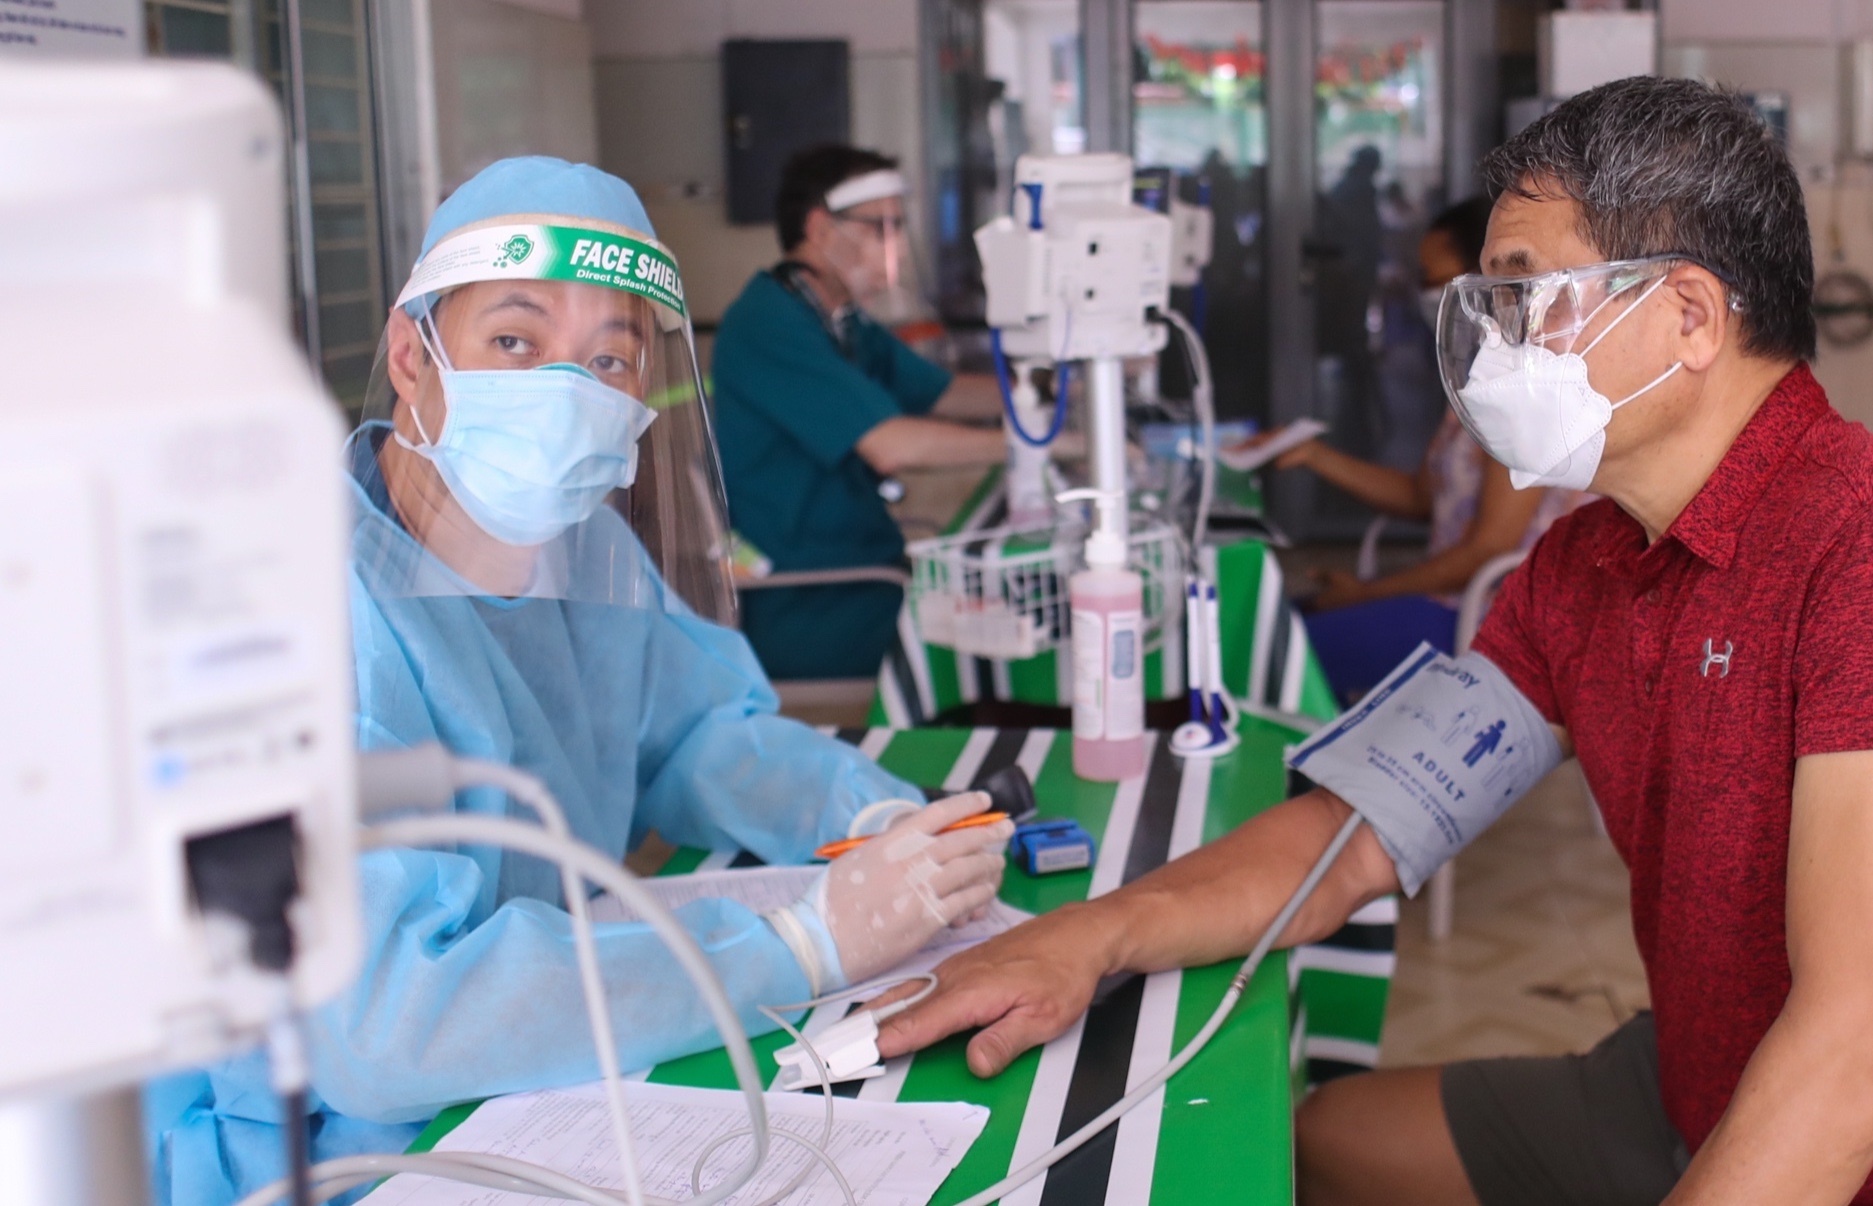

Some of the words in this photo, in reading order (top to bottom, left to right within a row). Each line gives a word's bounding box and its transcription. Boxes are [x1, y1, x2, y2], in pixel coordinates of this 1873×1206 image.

[570, 239, 634, 274] FACE
[634, 253, 684, 300] SHIELD
[576, 269, 611, 282] Direct
[613, 275, 646, 292] Splash
[647, 286, 681, 310] Protection
[1412, 751, 1465, 802] ADULT
